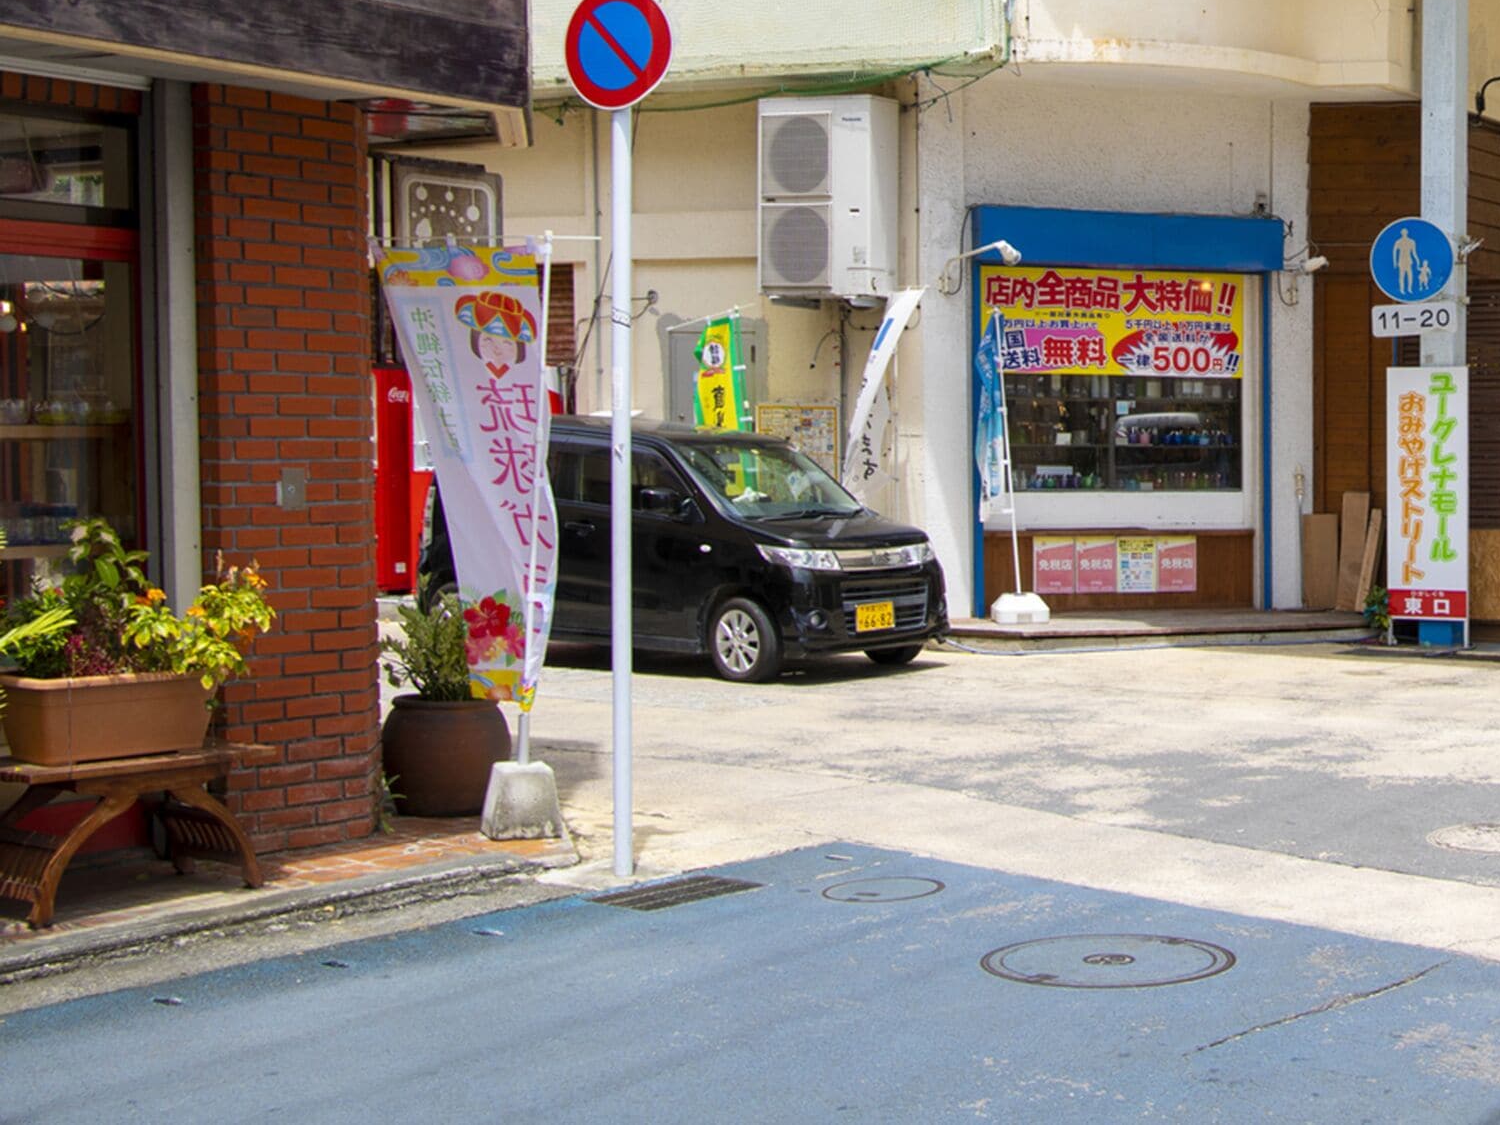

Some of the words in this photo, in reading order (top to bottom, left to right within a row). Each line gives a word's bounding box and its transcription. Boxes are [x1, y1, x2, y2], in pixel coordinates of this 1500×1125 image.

[1378, 308, 1450, 330] 11-20
[1397, 391, 1426, 587] おみやげストリート
[1428, 371, 1458, 563] ユーグレナモール
[1403, 596, 1451, 615] 東口
